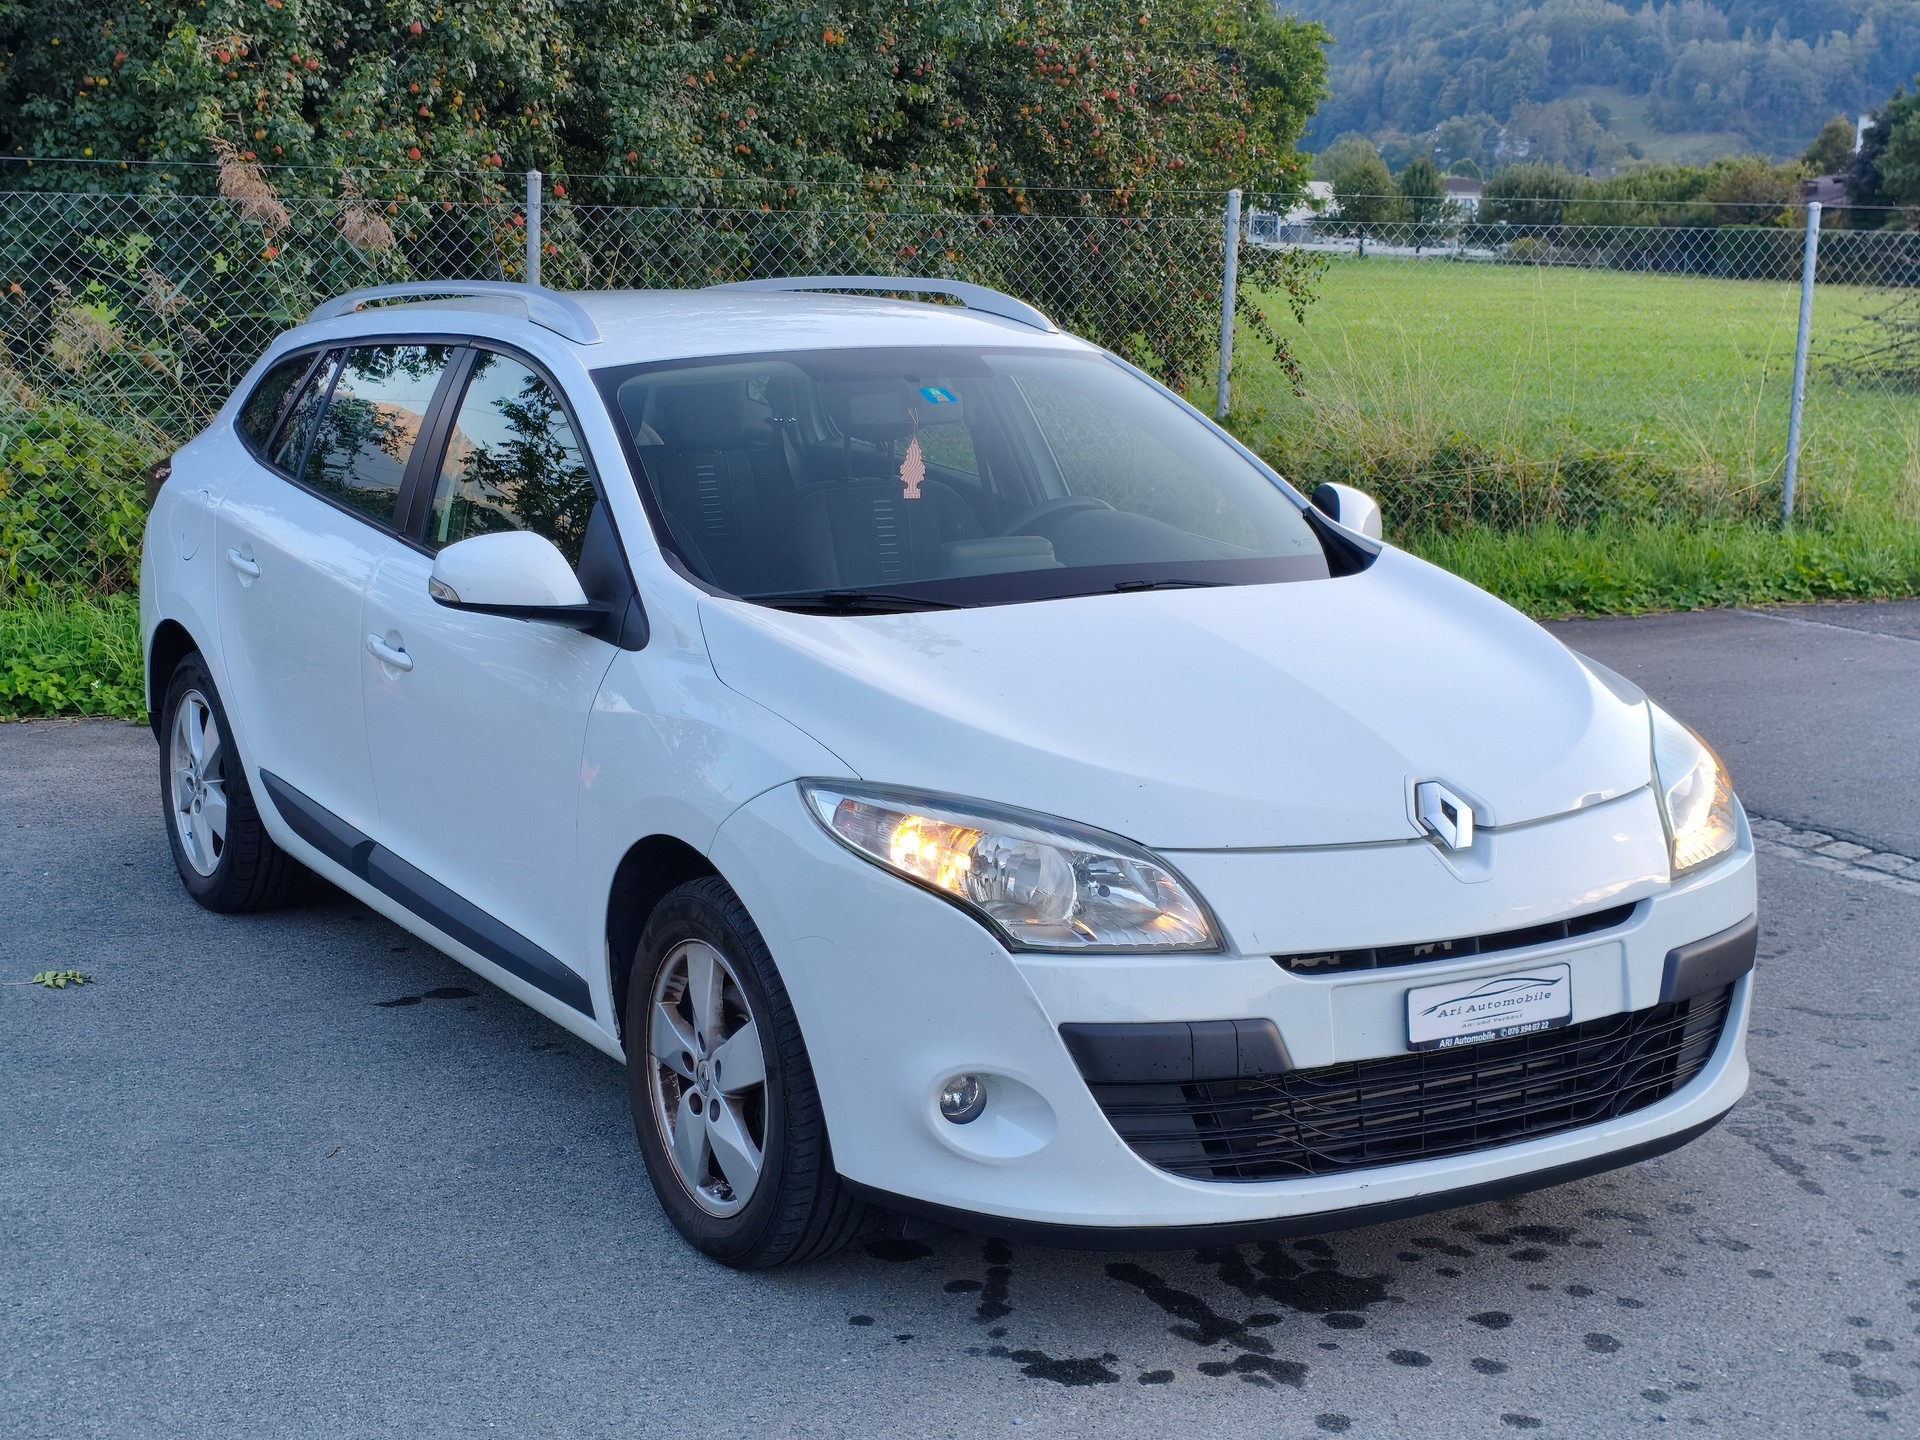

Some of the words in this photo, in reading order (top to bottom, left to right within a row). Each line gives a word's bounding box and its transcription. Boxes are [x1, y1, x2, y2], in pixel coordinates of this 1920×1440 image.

[1437, 1006, 1462, 1018] Ari
[1466, 992, 1552, 1013] Automobile
[1439, 1038, 1453, 1048] ARI
[1453, 1030, 1496, 1046] Automobile
[1507, 1026, 1520, 1036] 076
[1532, 1021, 1541, 1031] 07
[1541, 1020, 1550, 1030] 22
[1477, 1018, 1491, 1026] und
